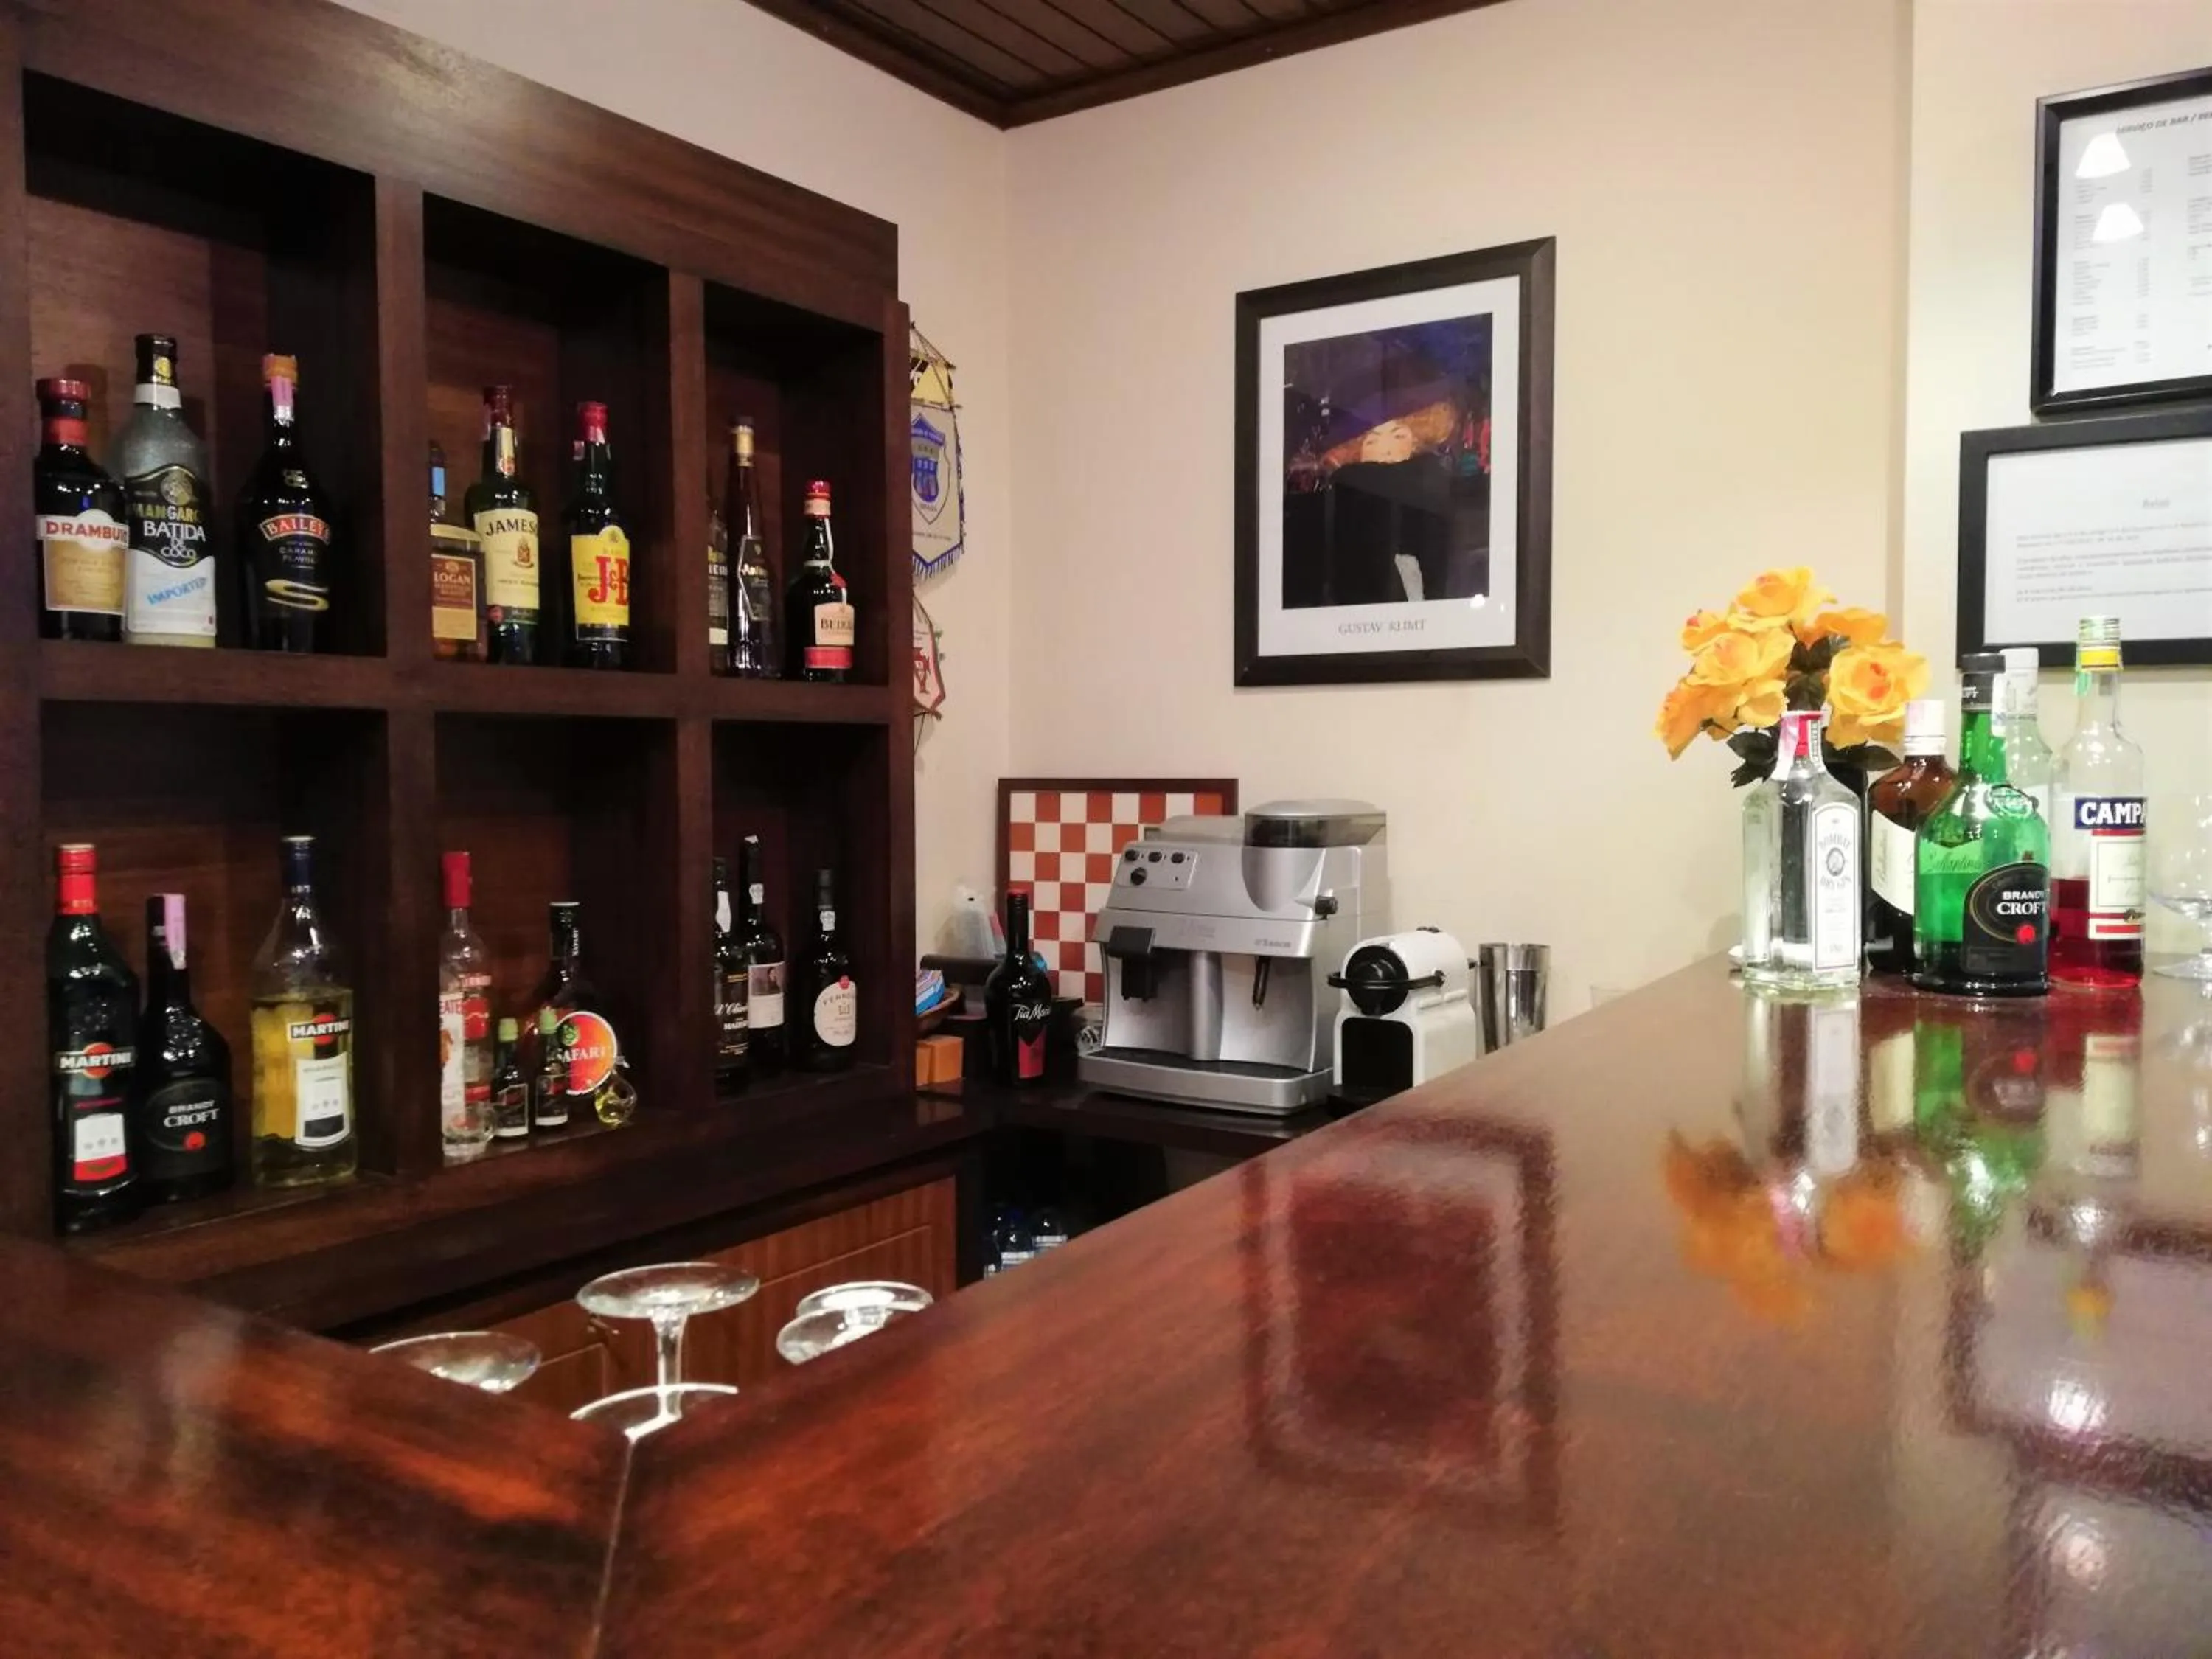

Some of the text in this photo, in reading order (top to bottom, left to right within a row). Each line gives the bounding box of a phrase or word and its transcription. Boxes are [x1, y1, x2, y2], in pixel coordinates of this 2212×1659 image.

[143, 519, 206, 542] BATIDA
[160, 546, 197, 559] COCO
[434, 572, 471, 585] LOGAN
[1338, 618, 1428, 634] GUSTAV KLIMT
[293, 1020, 349, 1037] MARTINI
[60, 1051, 132, 1069] MARTINI
[163, 1108, 220, 1128] CROFT
